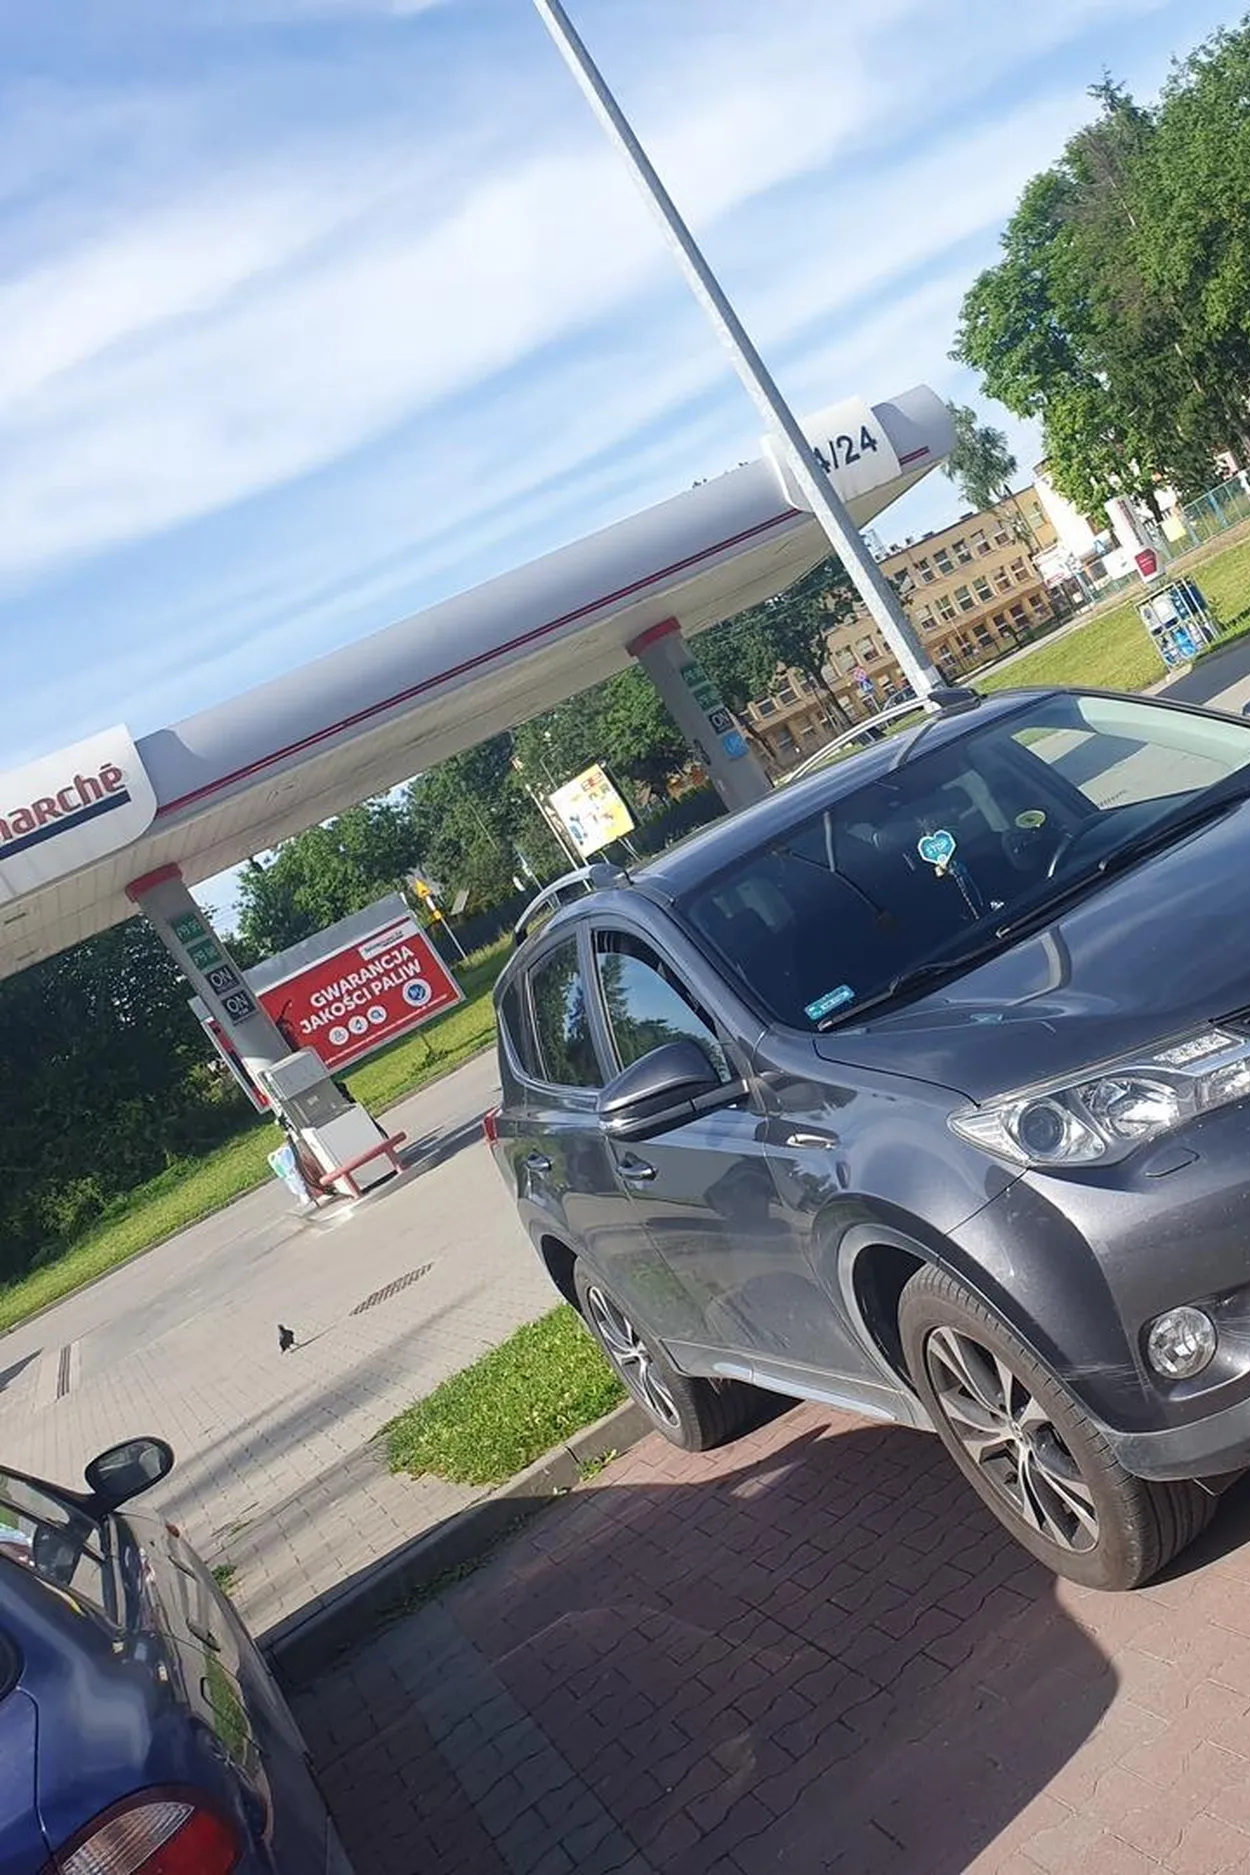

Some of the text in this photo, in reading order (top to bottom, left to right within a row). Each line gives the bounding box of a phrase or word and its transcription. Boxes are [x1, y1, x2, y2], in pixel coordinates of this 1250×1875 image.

[812, 425, 877, 473] 4/24
[210, 967, 233, 987] ON
[300, 987, 372, 1035] JAKOŚCI
[370, 959, 422, 996] PALIW
[310, 945, 415, 1008] GWARANCJA
[226, 993, 248, 1013] ON
